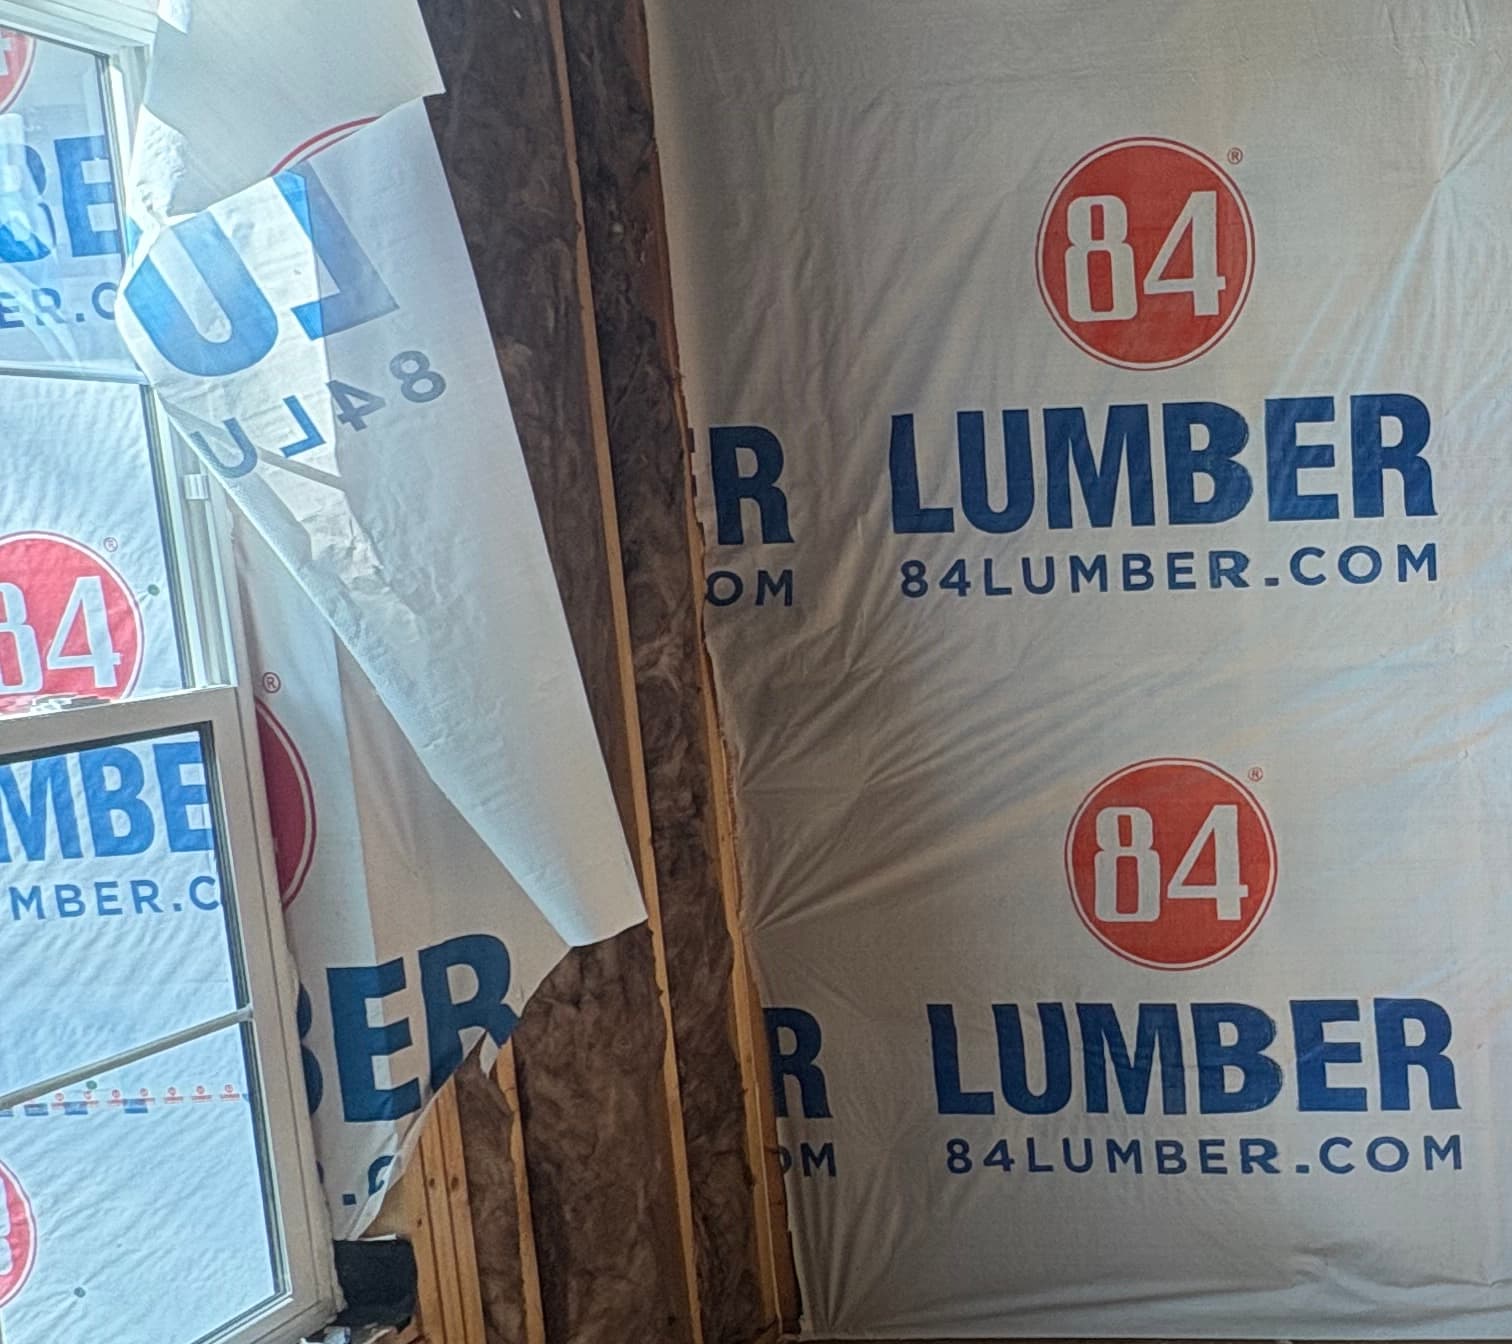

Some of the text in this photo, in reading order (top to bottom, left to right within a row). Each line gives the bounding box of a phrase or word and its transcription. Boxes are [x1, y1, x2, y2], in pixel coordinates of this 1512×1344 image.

[1065, 191, 1227, 323] 84
[690, 426, 795, 546] R
[889, 393, 1439, 534] LUMBER
[901, 543, 1439, 599] 84LUMBER.COM
[1094, 804, 1250, 924] 84
[927, 997, 1462, 1116] LUMBER
[946, 1132, 1465, 1177] 84LUMBER.COM
